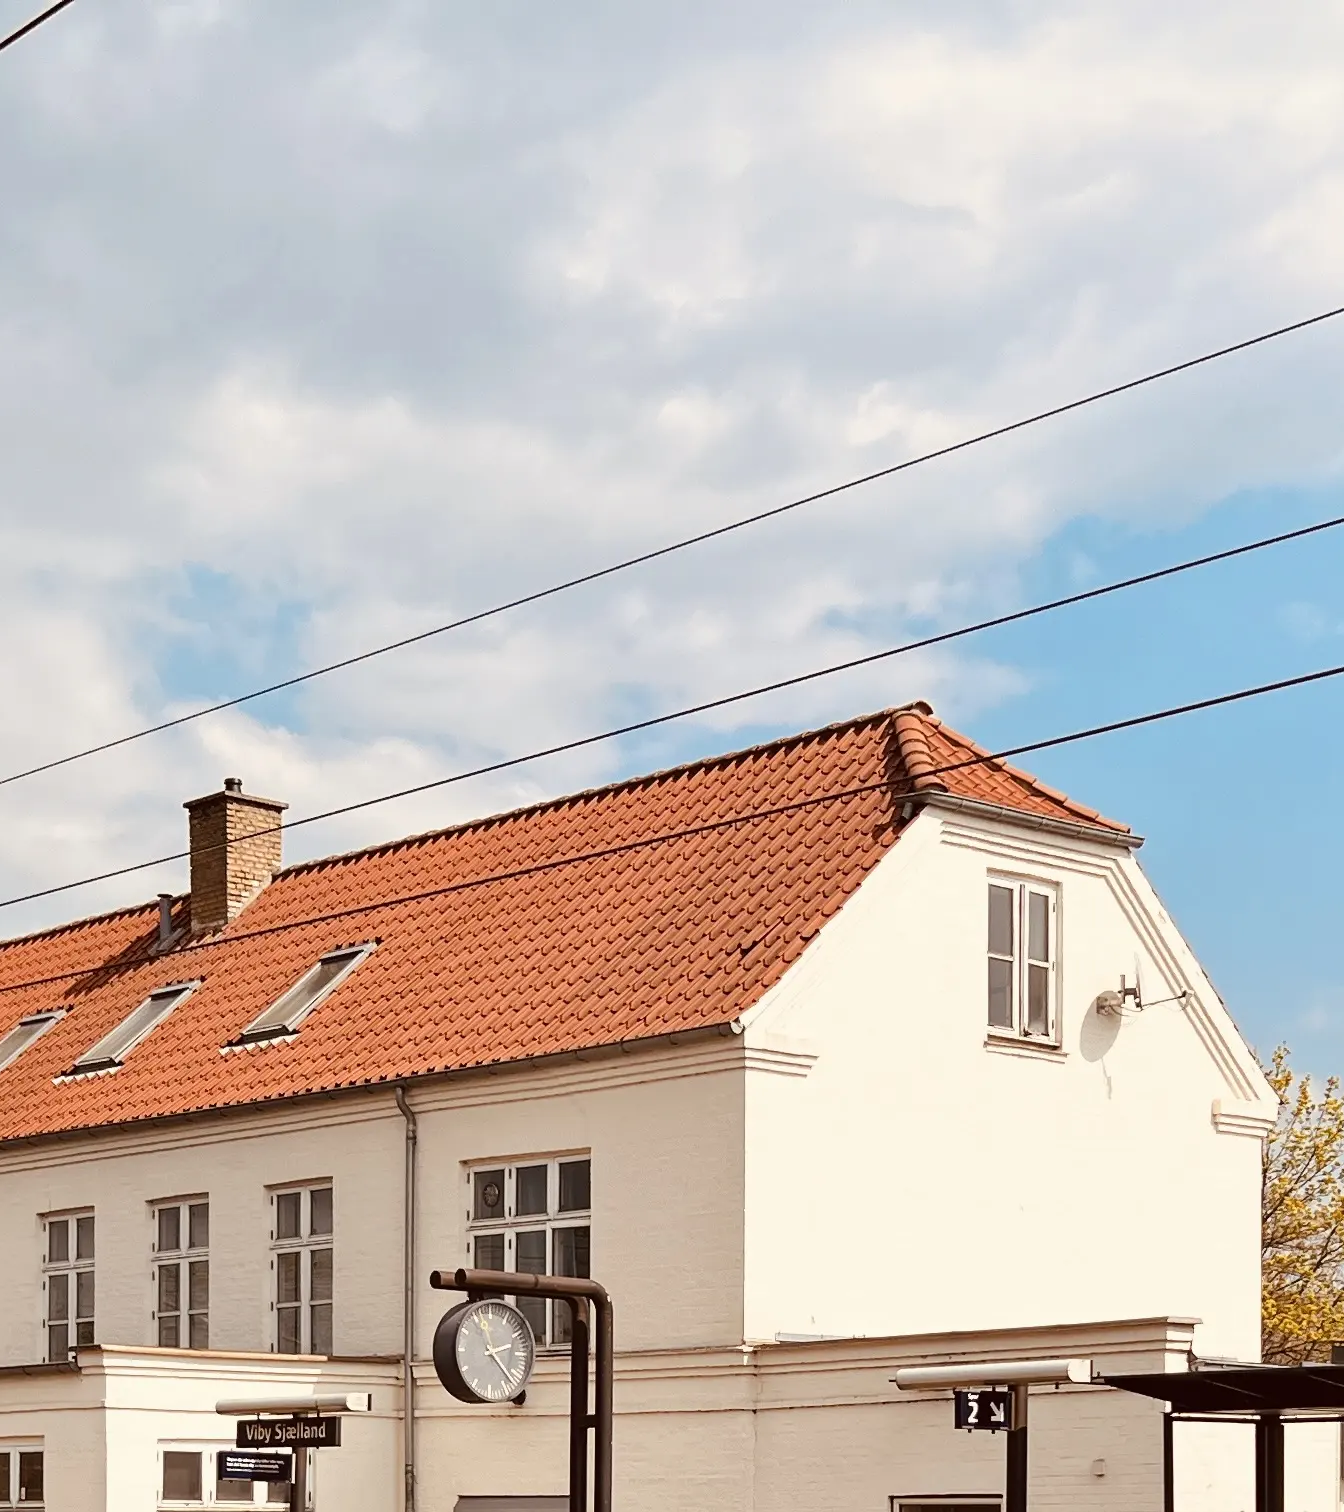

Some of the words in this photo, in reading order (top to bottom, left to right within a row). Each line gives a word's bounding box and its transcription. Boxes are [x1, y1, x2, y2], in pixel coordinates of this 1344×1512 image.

[968, 1401, 979, 1423] 2
[245, 1423, 272, 1443] Viby
[274, 1422, 326, 1443] Sjælland
